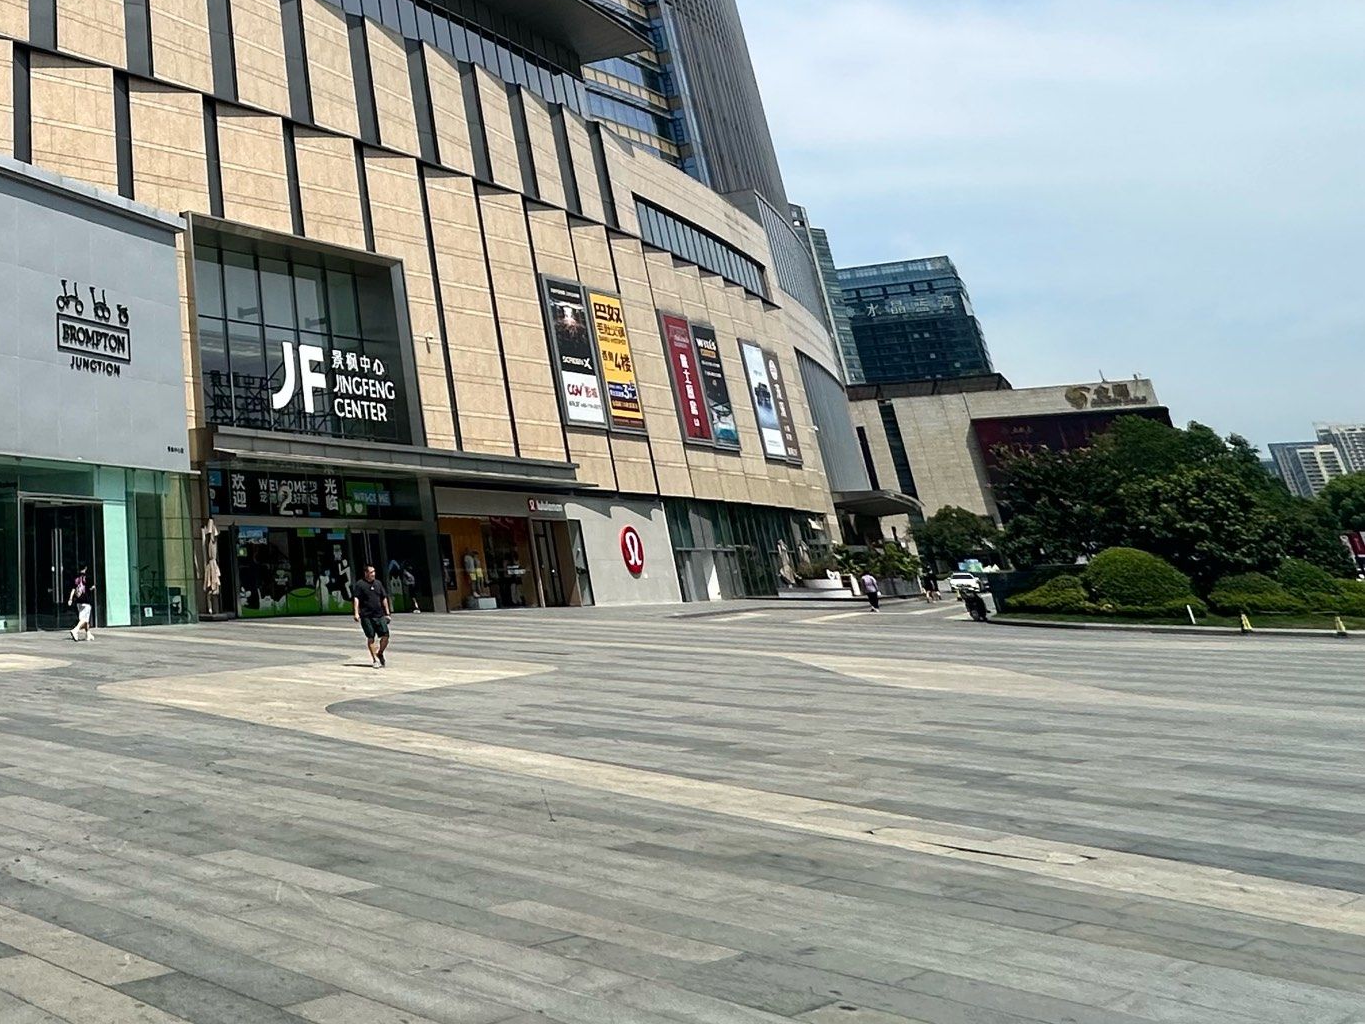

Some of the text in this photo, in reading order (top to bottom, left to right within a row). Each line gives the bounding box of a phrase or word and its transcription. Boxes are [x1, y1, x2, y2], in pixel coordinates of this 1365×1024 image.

[593, 302, 623, 323] 巴奴
[62, 323, 126, 354] BROMPTON
[70, 356, 121, 377] JUNCTION
[331, 349, 385, 376] 景枫中心
[272, 341, 327, 414] JF
[333, 374, 396, 400] JINGFENG
[335, 398, 387, 422] CENTER
[231, 473, 247, 509] 欢迎
[324, 478, 339, 511] 光临
